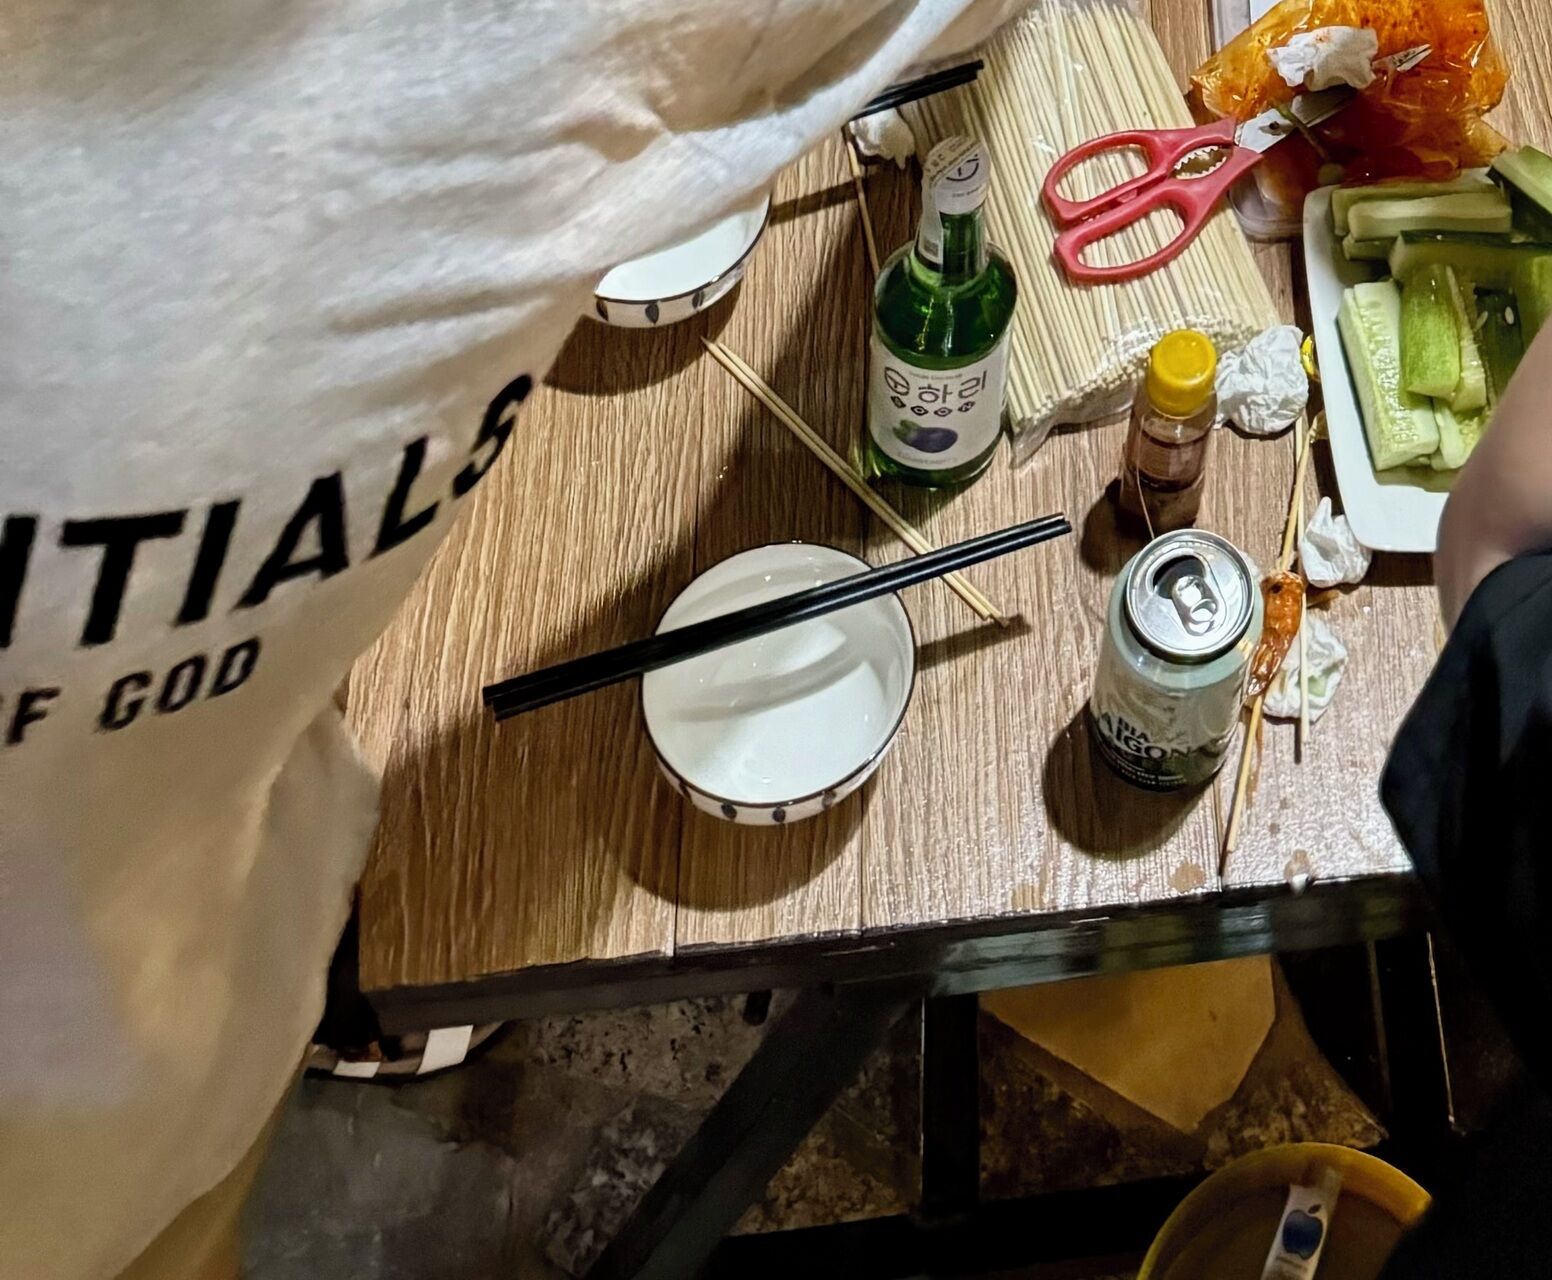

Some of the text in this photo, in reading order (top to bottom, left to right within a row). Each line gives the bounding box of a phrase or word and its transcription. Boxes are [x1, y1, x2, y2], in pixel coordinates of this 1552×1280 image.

[0, 637, 261, 747] F GOD
[1116, 717, 1152, 744] BIA
